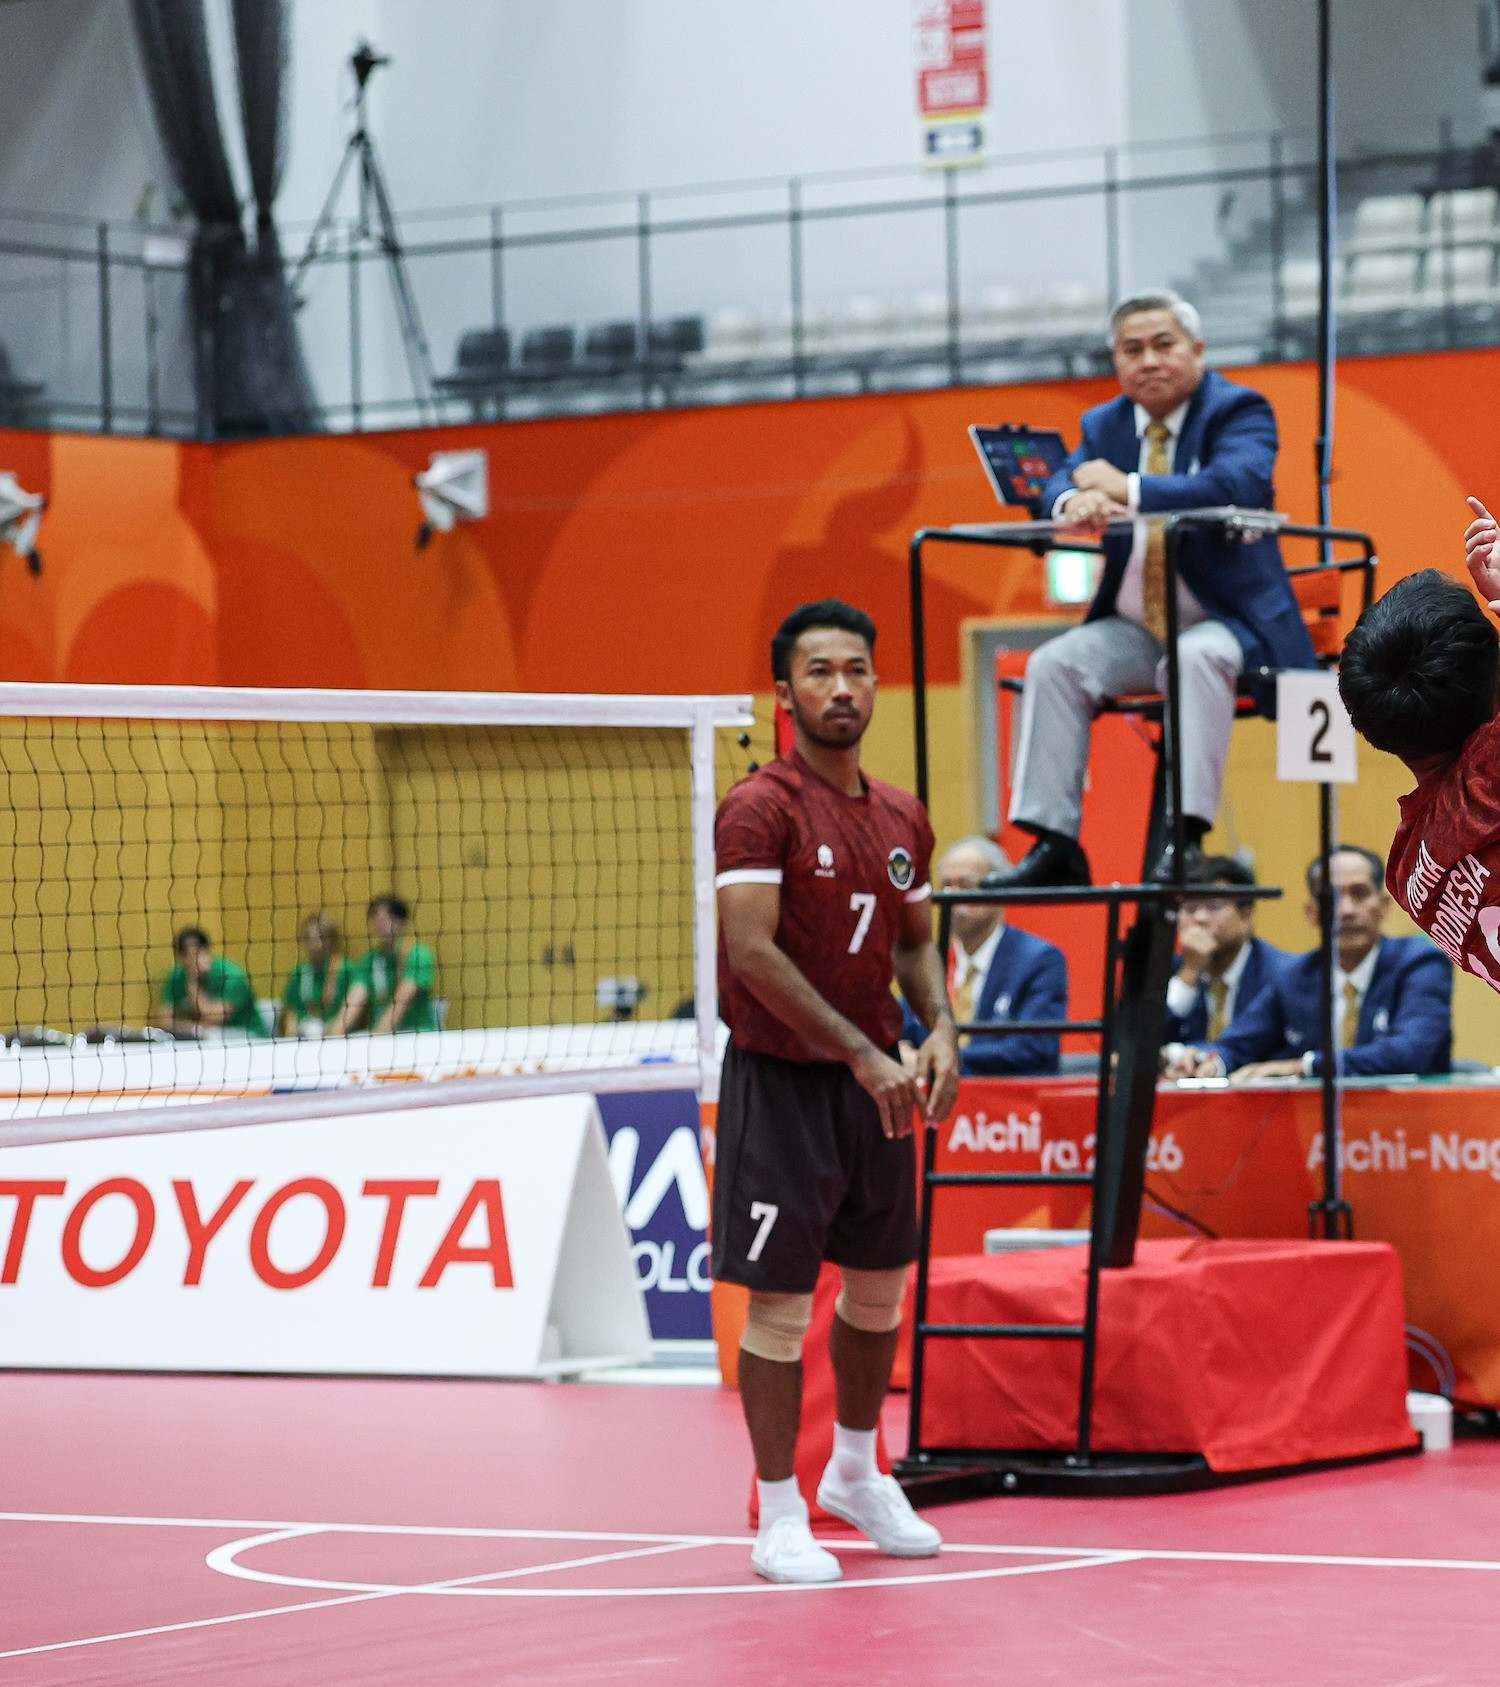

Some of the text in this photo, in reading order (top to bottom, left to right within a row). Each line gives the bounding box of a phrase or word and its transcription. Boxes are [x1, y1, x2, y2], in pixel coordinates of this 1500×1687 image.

[1310, 700, 1332, 762] 2
[847, 892, 877, 954] 7
[1430, 853, 1491, 966] NDONESIA
[0, 1176, 515, 1289] TOYOTA
[746, 1200, 779, 1262] 7
